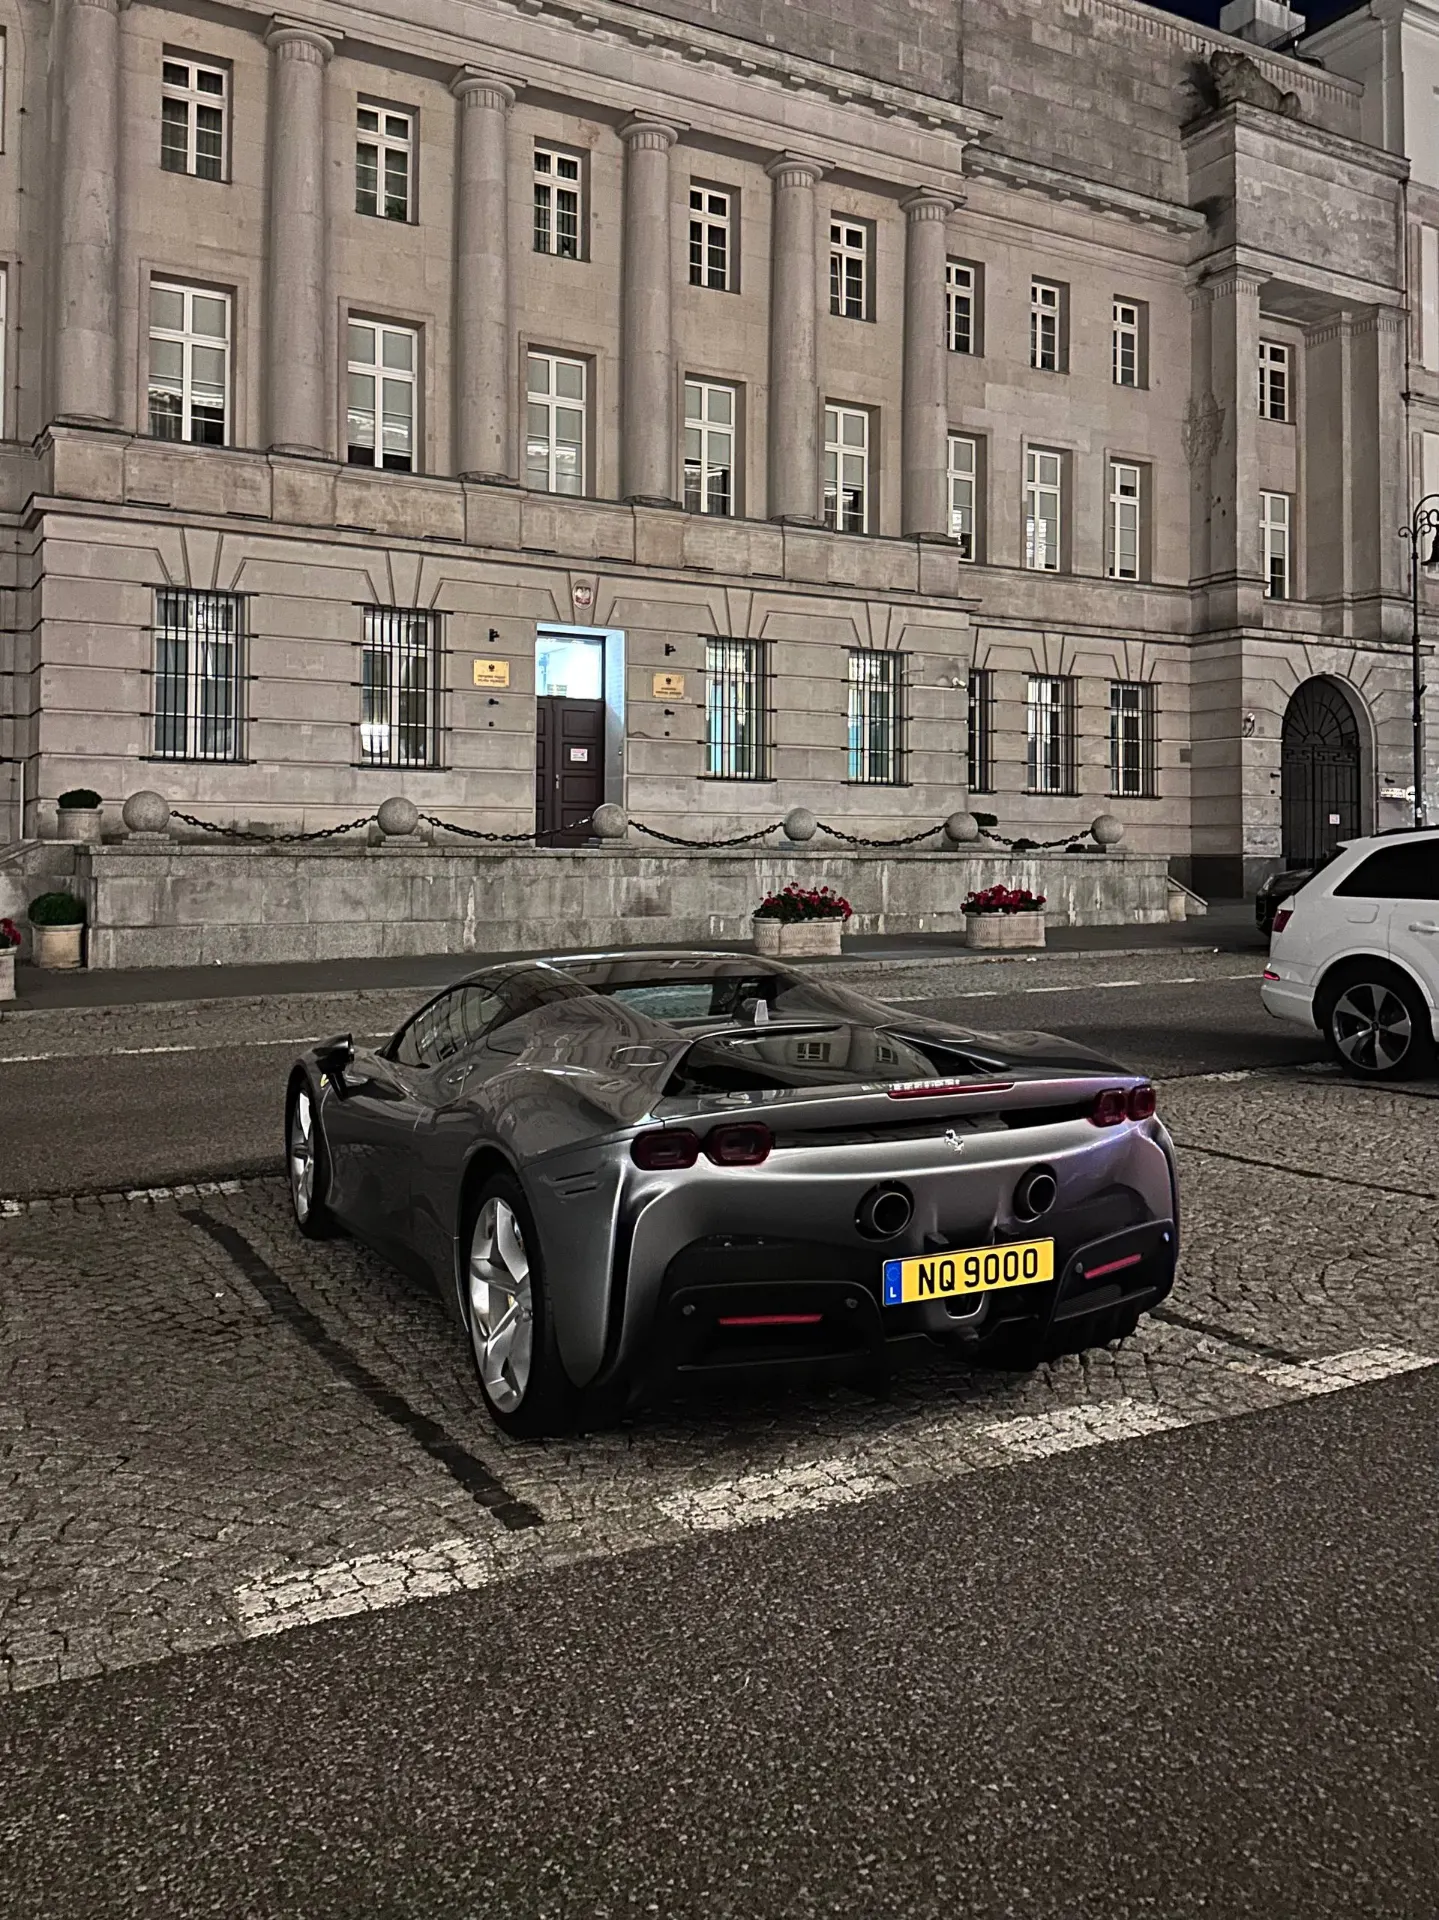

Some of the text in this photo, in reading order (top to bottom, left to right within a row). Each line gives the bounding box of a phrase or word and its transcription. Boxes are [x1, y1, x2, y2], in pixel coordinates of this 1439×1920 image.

[918, 1248, 1038, 1296] NQ 9000
[889, 1286, 897, 1298] L
